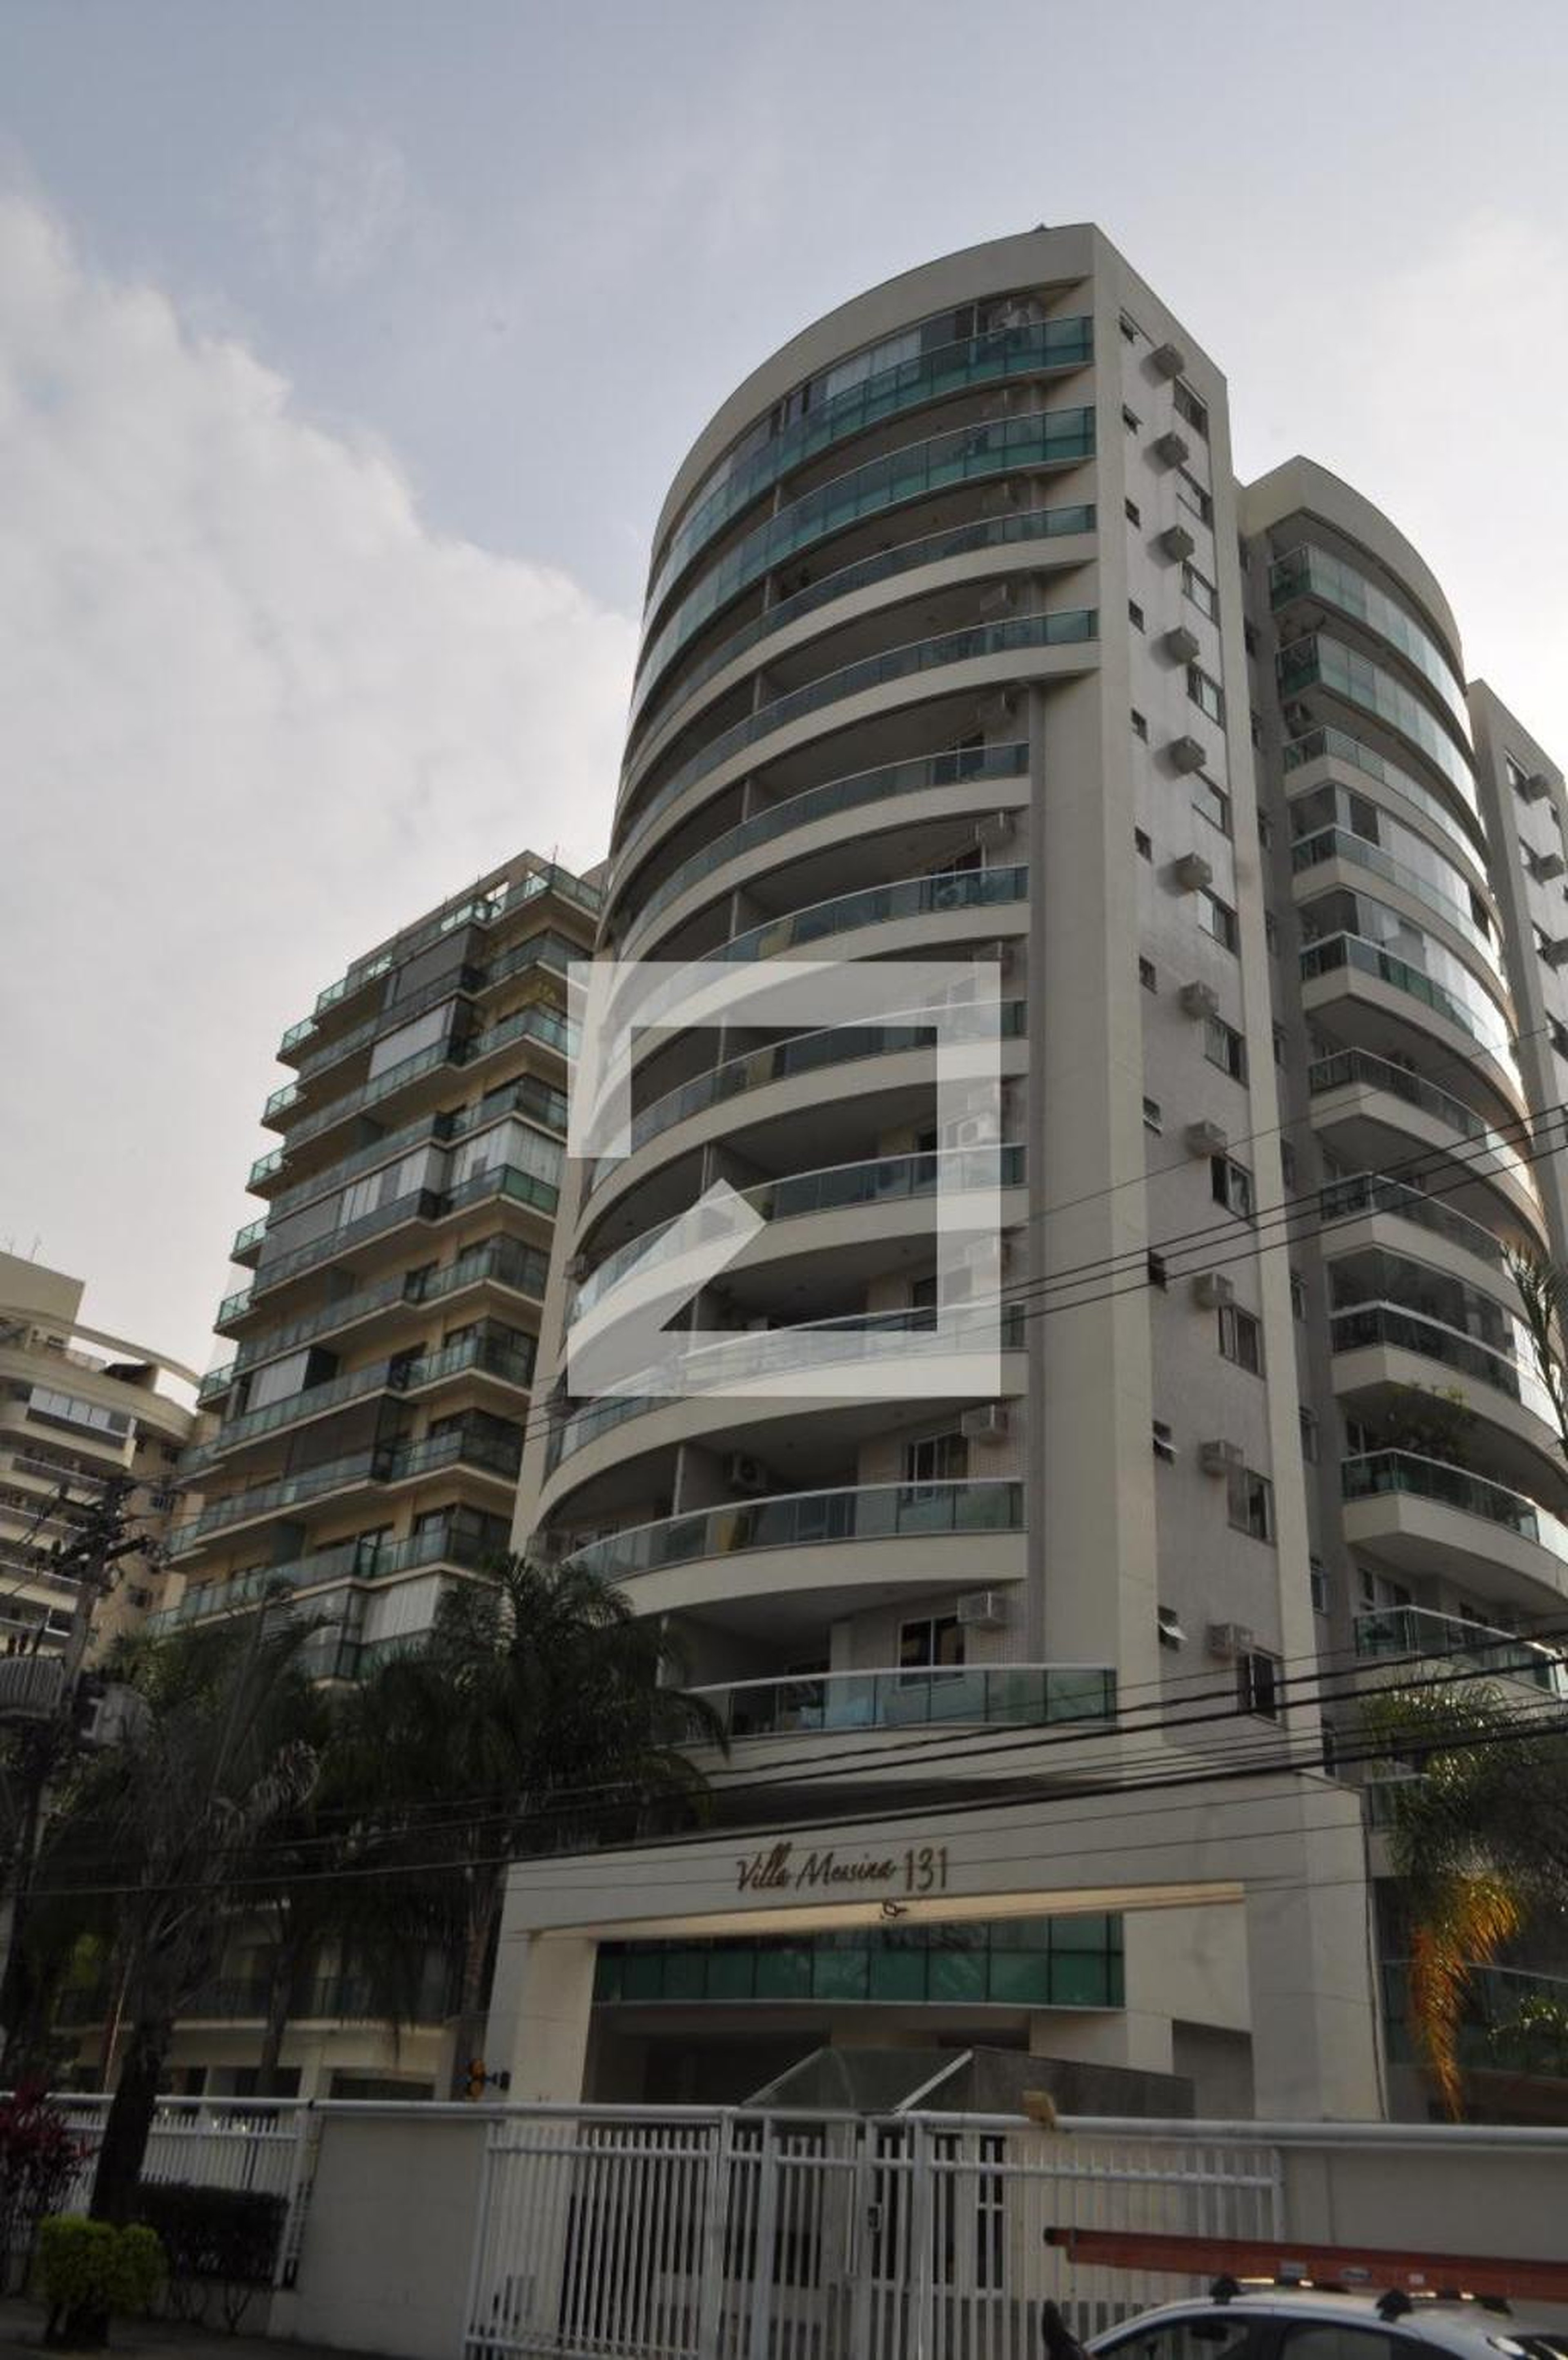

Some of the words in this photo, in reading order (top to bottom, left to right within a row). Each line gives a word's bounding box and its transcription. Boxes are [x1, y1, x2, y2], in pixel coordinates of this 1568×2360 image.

[736, 1841, 793, 1892] Villa
[796, 1851, 897, 1890] Messina
[905, 1846, 948, 1892] 131
